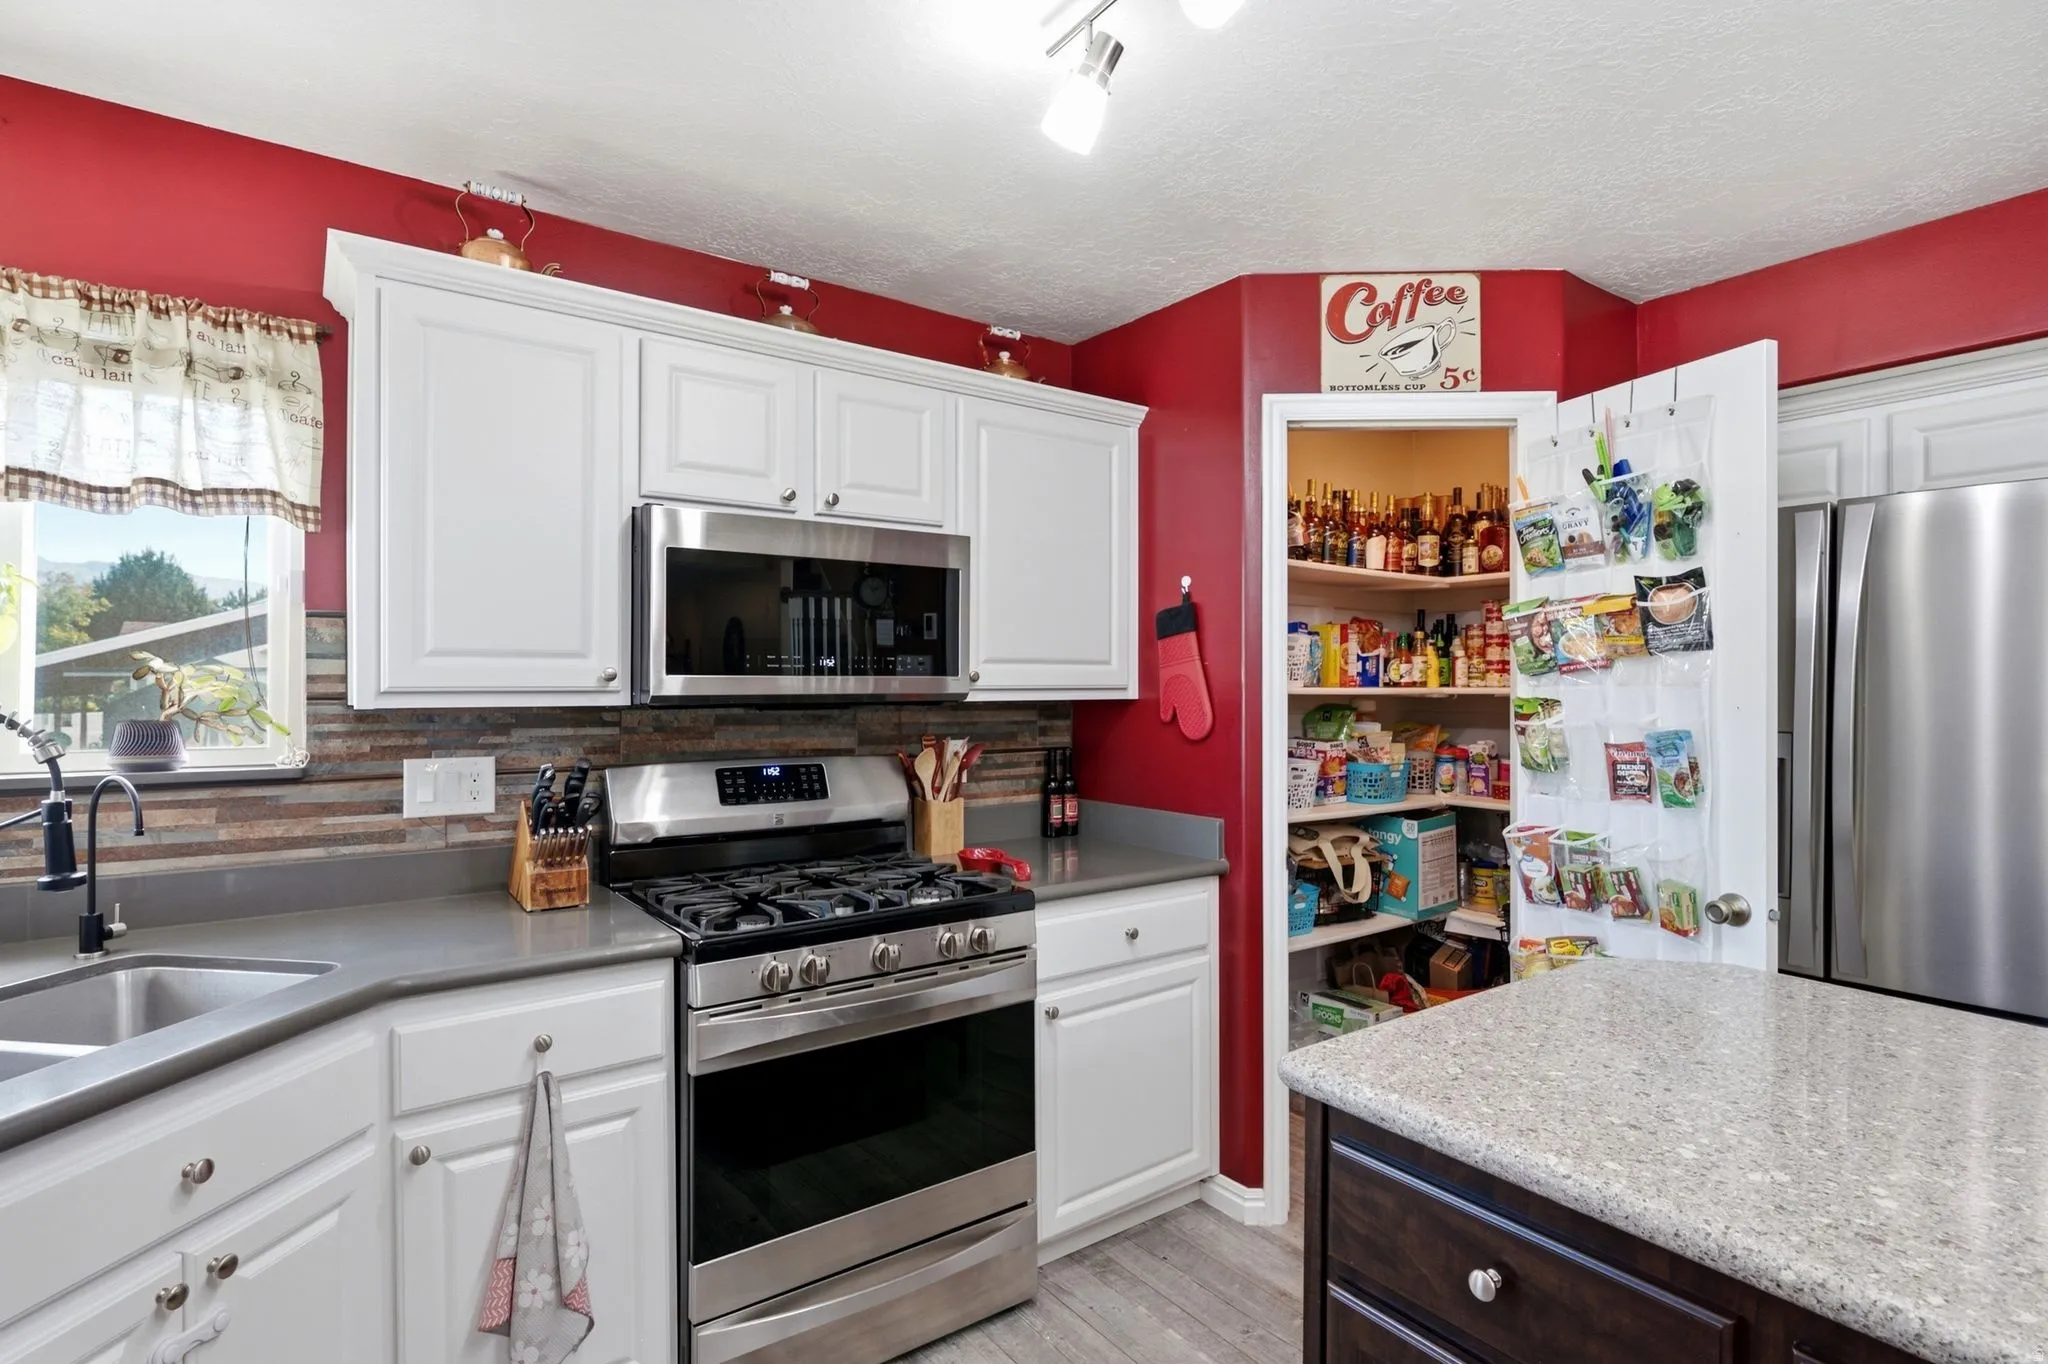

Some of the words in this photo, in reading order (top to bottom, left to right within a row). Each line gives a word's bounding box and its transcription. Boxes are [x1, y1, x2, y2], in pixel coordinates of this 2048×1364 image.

[1325, 278, 1468, 344] Coffee
[196, 330, 216, 347] au
[101, 367, 133, 383] lait
[1329, 384, 1400, 392] BOTTOMLESS
[1404, 383, 1426, 391] CUP
[1562, 518, 1589, 530] GRAVY
